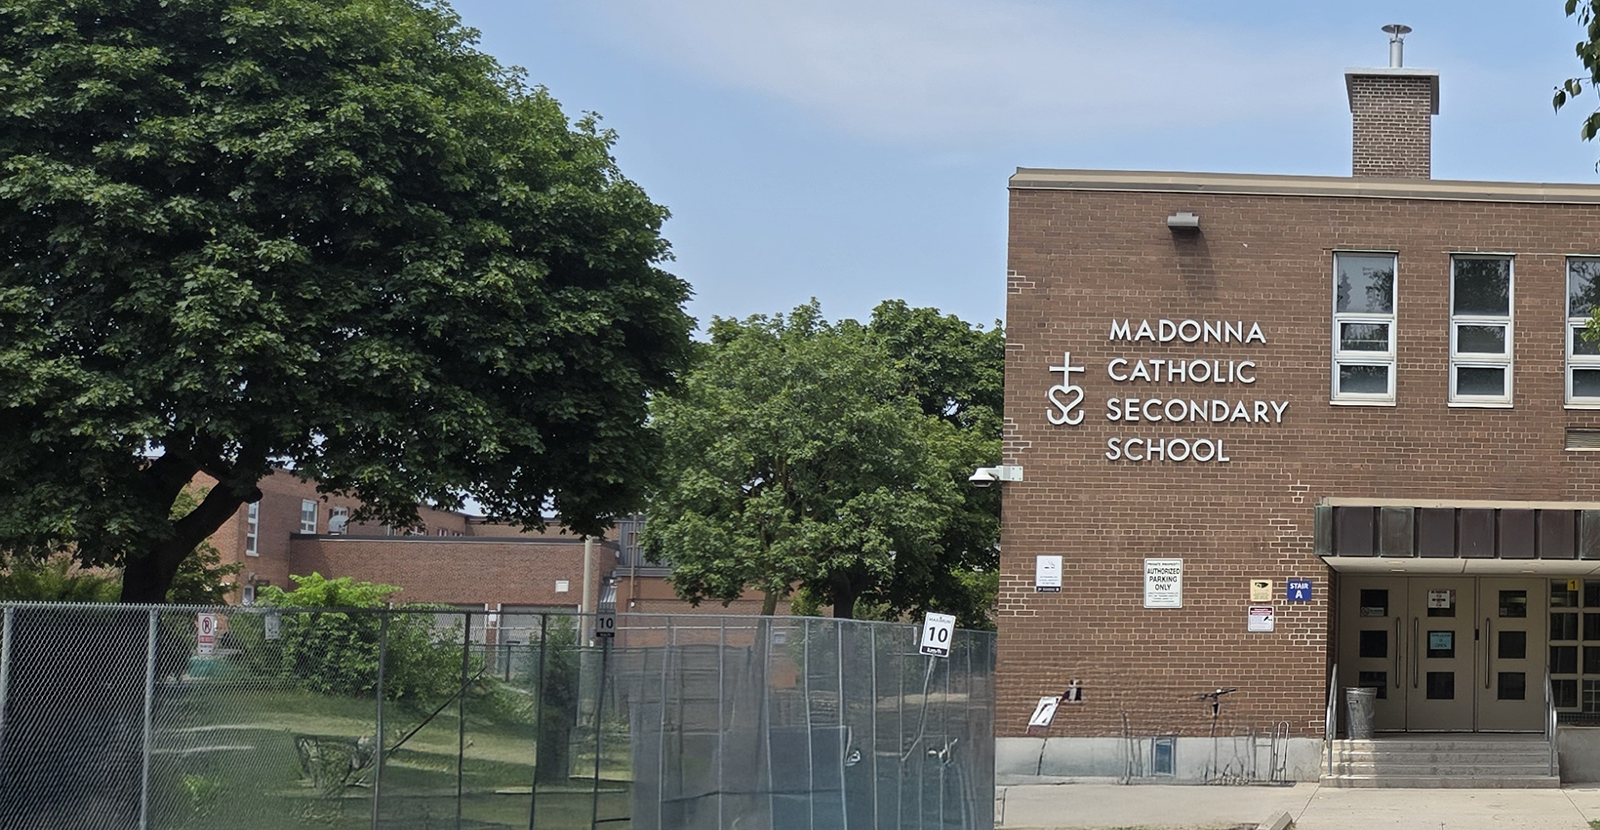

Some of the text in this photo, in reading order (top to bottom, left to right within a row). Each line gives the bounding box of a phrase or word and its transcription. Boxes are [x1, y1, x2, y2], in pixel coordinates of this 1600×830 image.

[1109, 318, 1267, 344] MADONNA
[1107, 358, 1256, 384] CATHOLIC
[1106, 397, 1289, 423] SECONDARY
[1105, 437, 1230, 462] SCHOOL
[1147, 567, 1180, 575] AUTHORIZED
[1149, 575, 1178, 583] PARKING
[1570, 580, 1576, 590] 1
[1289, 582, 1309, 590] STAIR
[1295, 590, 1303, 599] A
[599, 617, 614, 629] 10
[929, 626, 948, 643] 10
